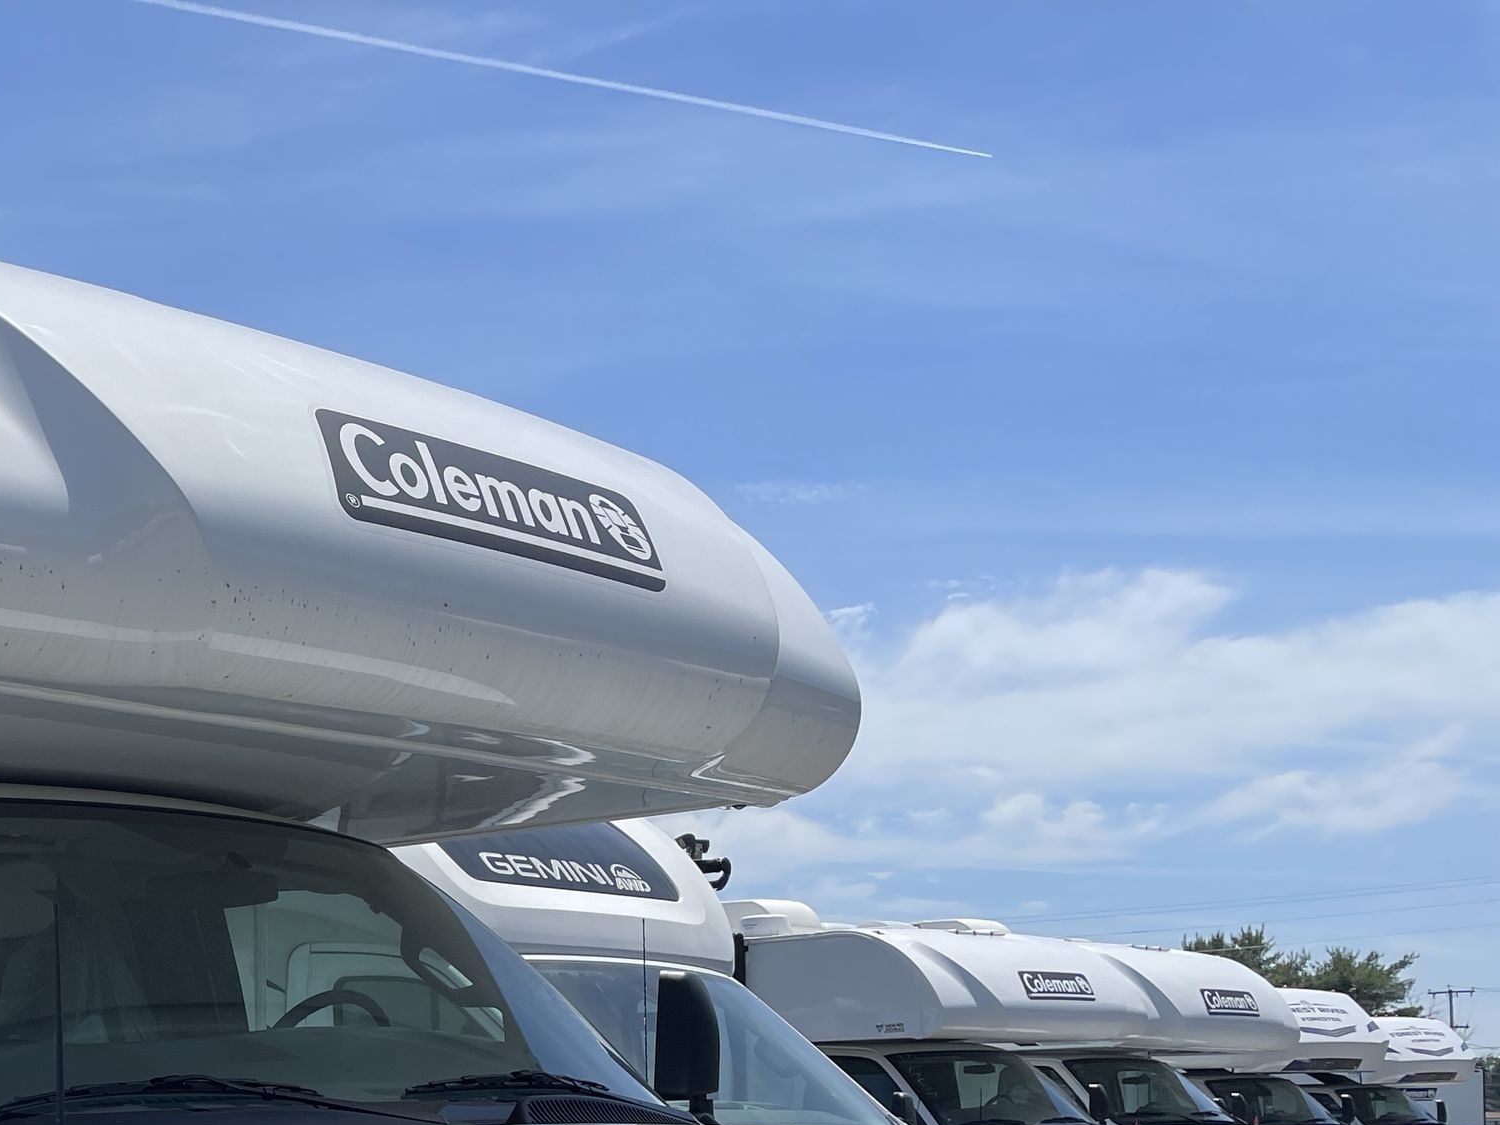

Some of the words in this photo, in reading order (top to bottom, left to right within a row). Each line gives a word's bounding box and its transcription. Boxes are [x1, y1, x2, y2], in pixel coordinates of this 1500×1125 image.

[339, 423, 601, 545] Coleman
[478, 851, 615, 886] GEMINI
[615, 877, 651, 893] AWD
[1022, 973, 1081, 994] Coleman
[1204, 991, 1249, 1011] Coleman
